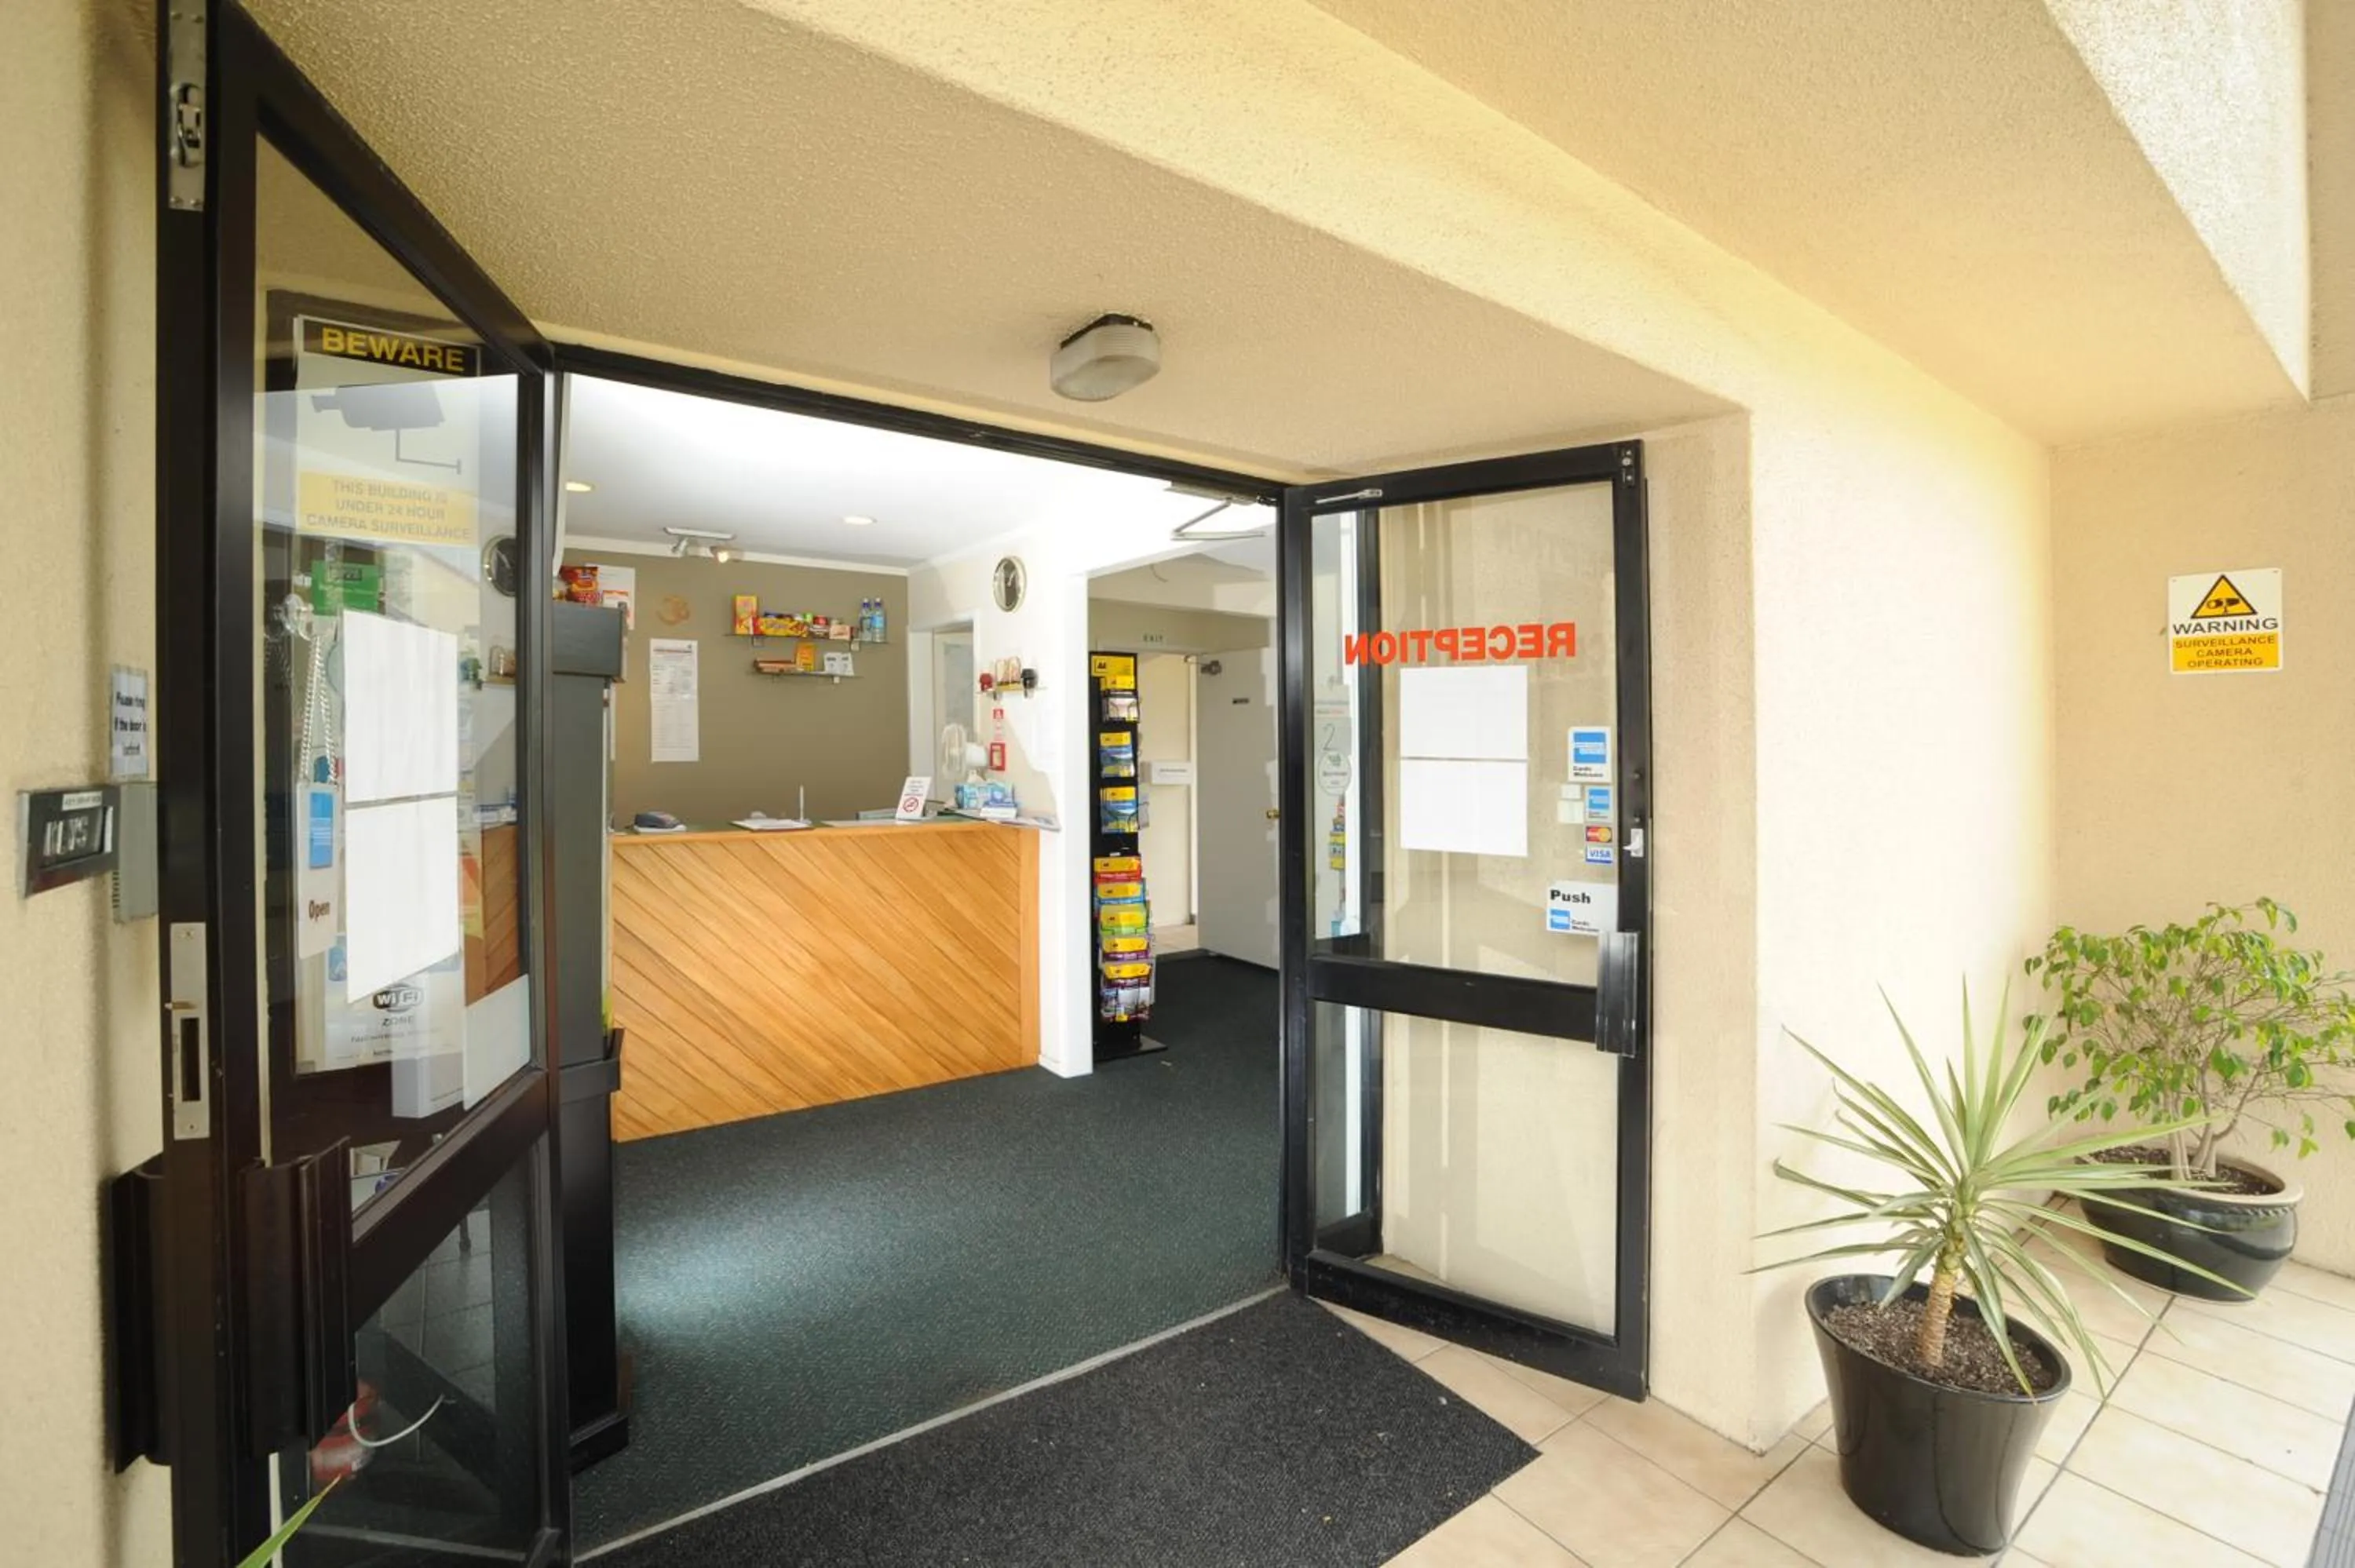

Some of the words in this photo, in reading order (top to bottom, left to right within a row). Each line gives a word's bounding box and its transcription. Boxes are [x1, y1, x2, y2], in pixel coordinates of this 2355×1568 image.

[323, 327, 465, 371] BEWARE
[333, 480, 363, 496] THIS
[368, 482, 431, 503] BUILDING
[336, 498, 384, 515] UNDER
[405, 504, 445, 520] HOUR
[306, 513, 367, 531] CAMERA
[371, 518, 472, 539] SURVEILLANCE
[2173, 618, 2279, 635] WARNING
[2175, 635, 2275, 648] SURVEILLANCE
[2196, 647, 2253, 658] CAMERA
[2188, 658, 2264, 668] OPERATING
[1590, 850, 1612, 859] VISA
[1550, 889, 1591, 904] Push
[309, 899, 330, 921] Open
